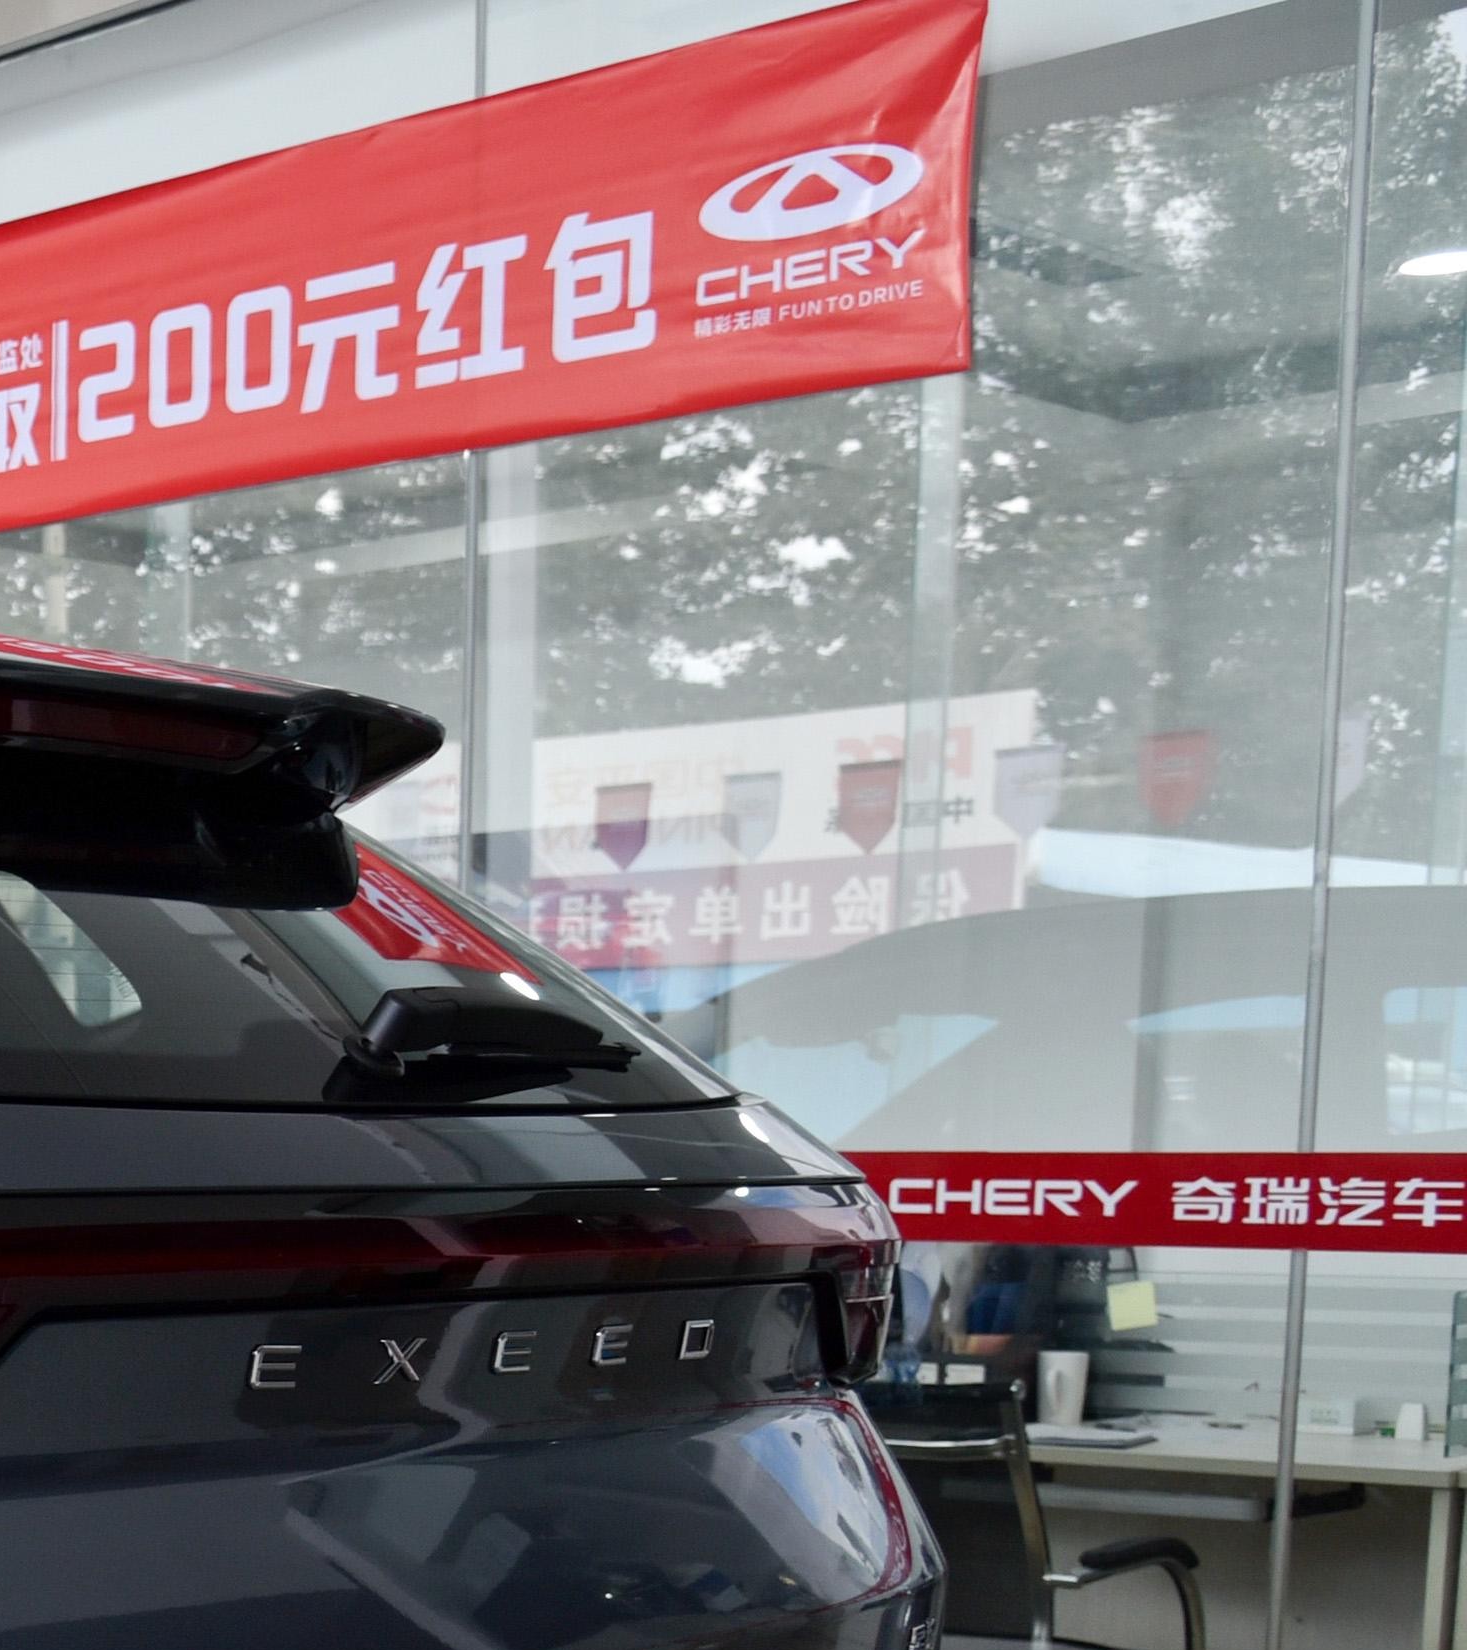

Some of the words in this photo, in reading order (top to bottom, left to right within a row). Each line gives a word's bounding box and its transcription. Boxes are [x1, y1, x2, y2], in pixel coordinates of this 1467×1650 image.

[696, 226, 926, 307] CHERY
[77, 211, 657, 442] 200元红包
[694, 307, 771, 338] 精彩无限
[778, 298, 823, 321] FUN
[824, 292, 855, 314] TO
[858, 279, 923, 308] DRIVE
[889, 1180, 1138, 1217] CHERY
[1171, 1177, 1465, 1228] 奇瑞汽车
[250, 1318, 715, 1391] EXEED
